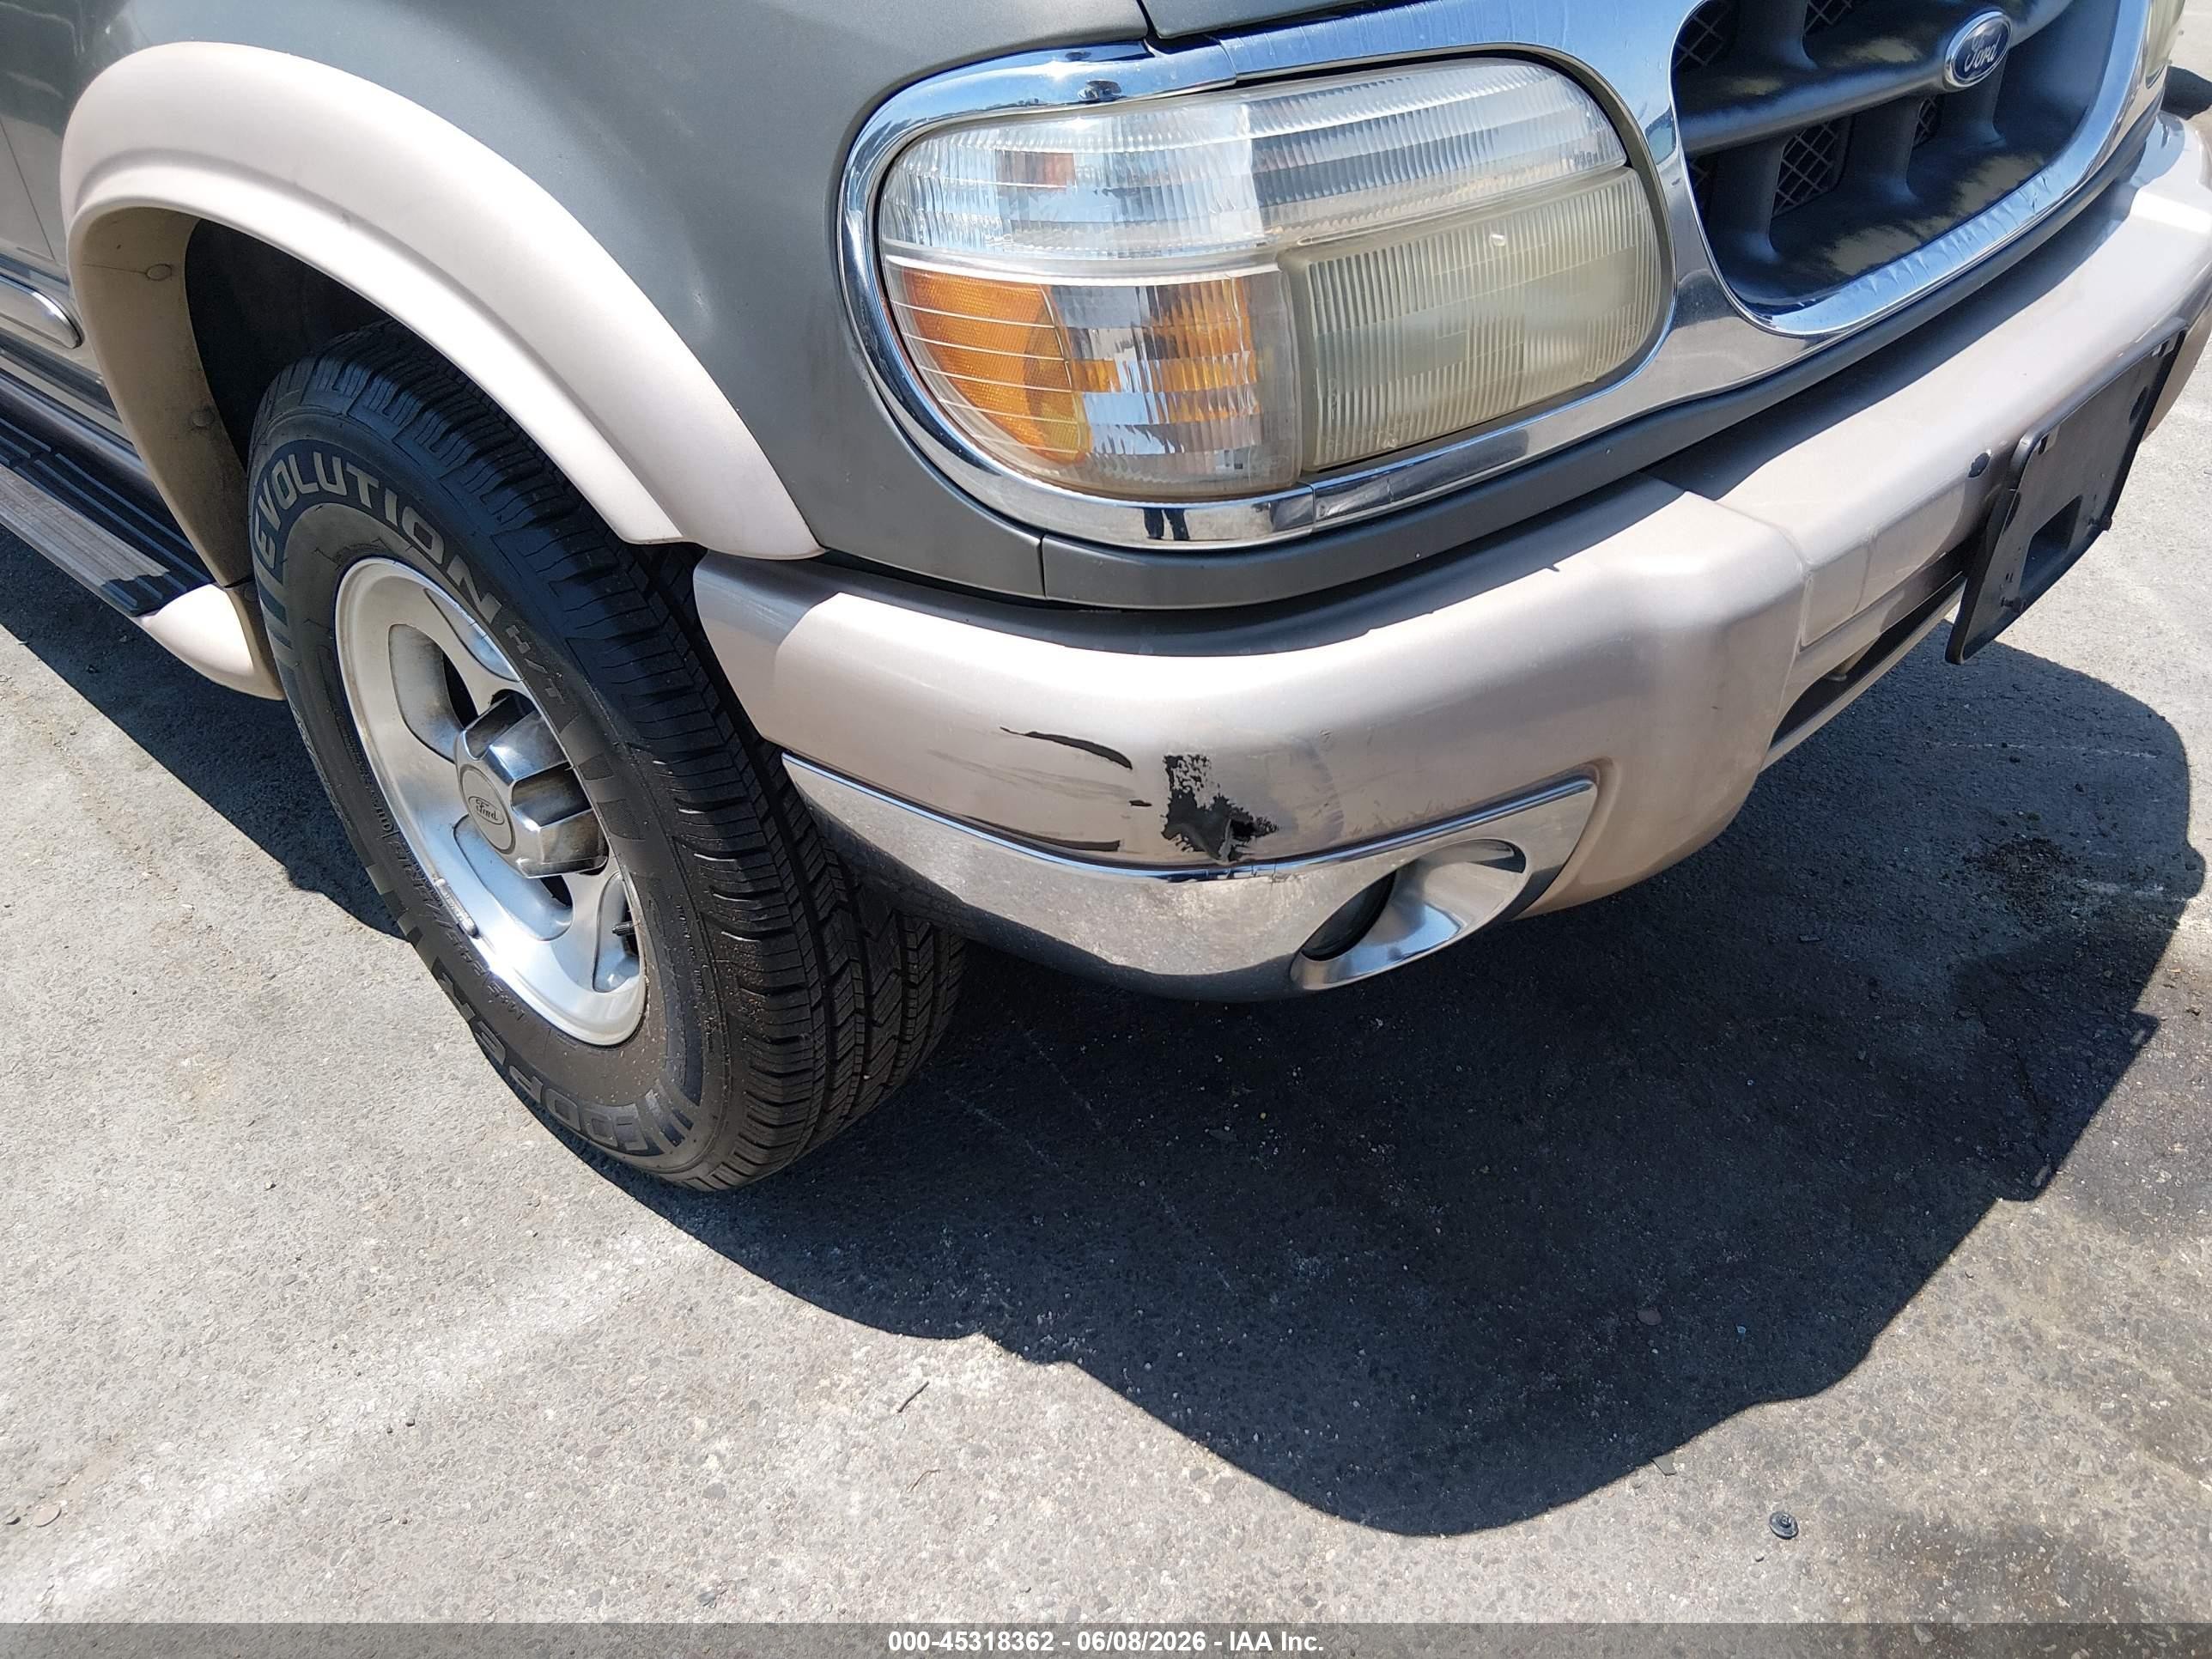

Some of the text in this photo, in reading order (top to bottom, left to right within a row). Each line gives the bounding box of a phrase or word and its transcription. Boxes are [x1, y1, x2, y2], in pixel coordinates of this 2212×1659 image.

[1963, 28, 2002, 73] Ford
[252, 451, 504, 625] EVOLUTION
[475, 799, 499, 821] Ford
